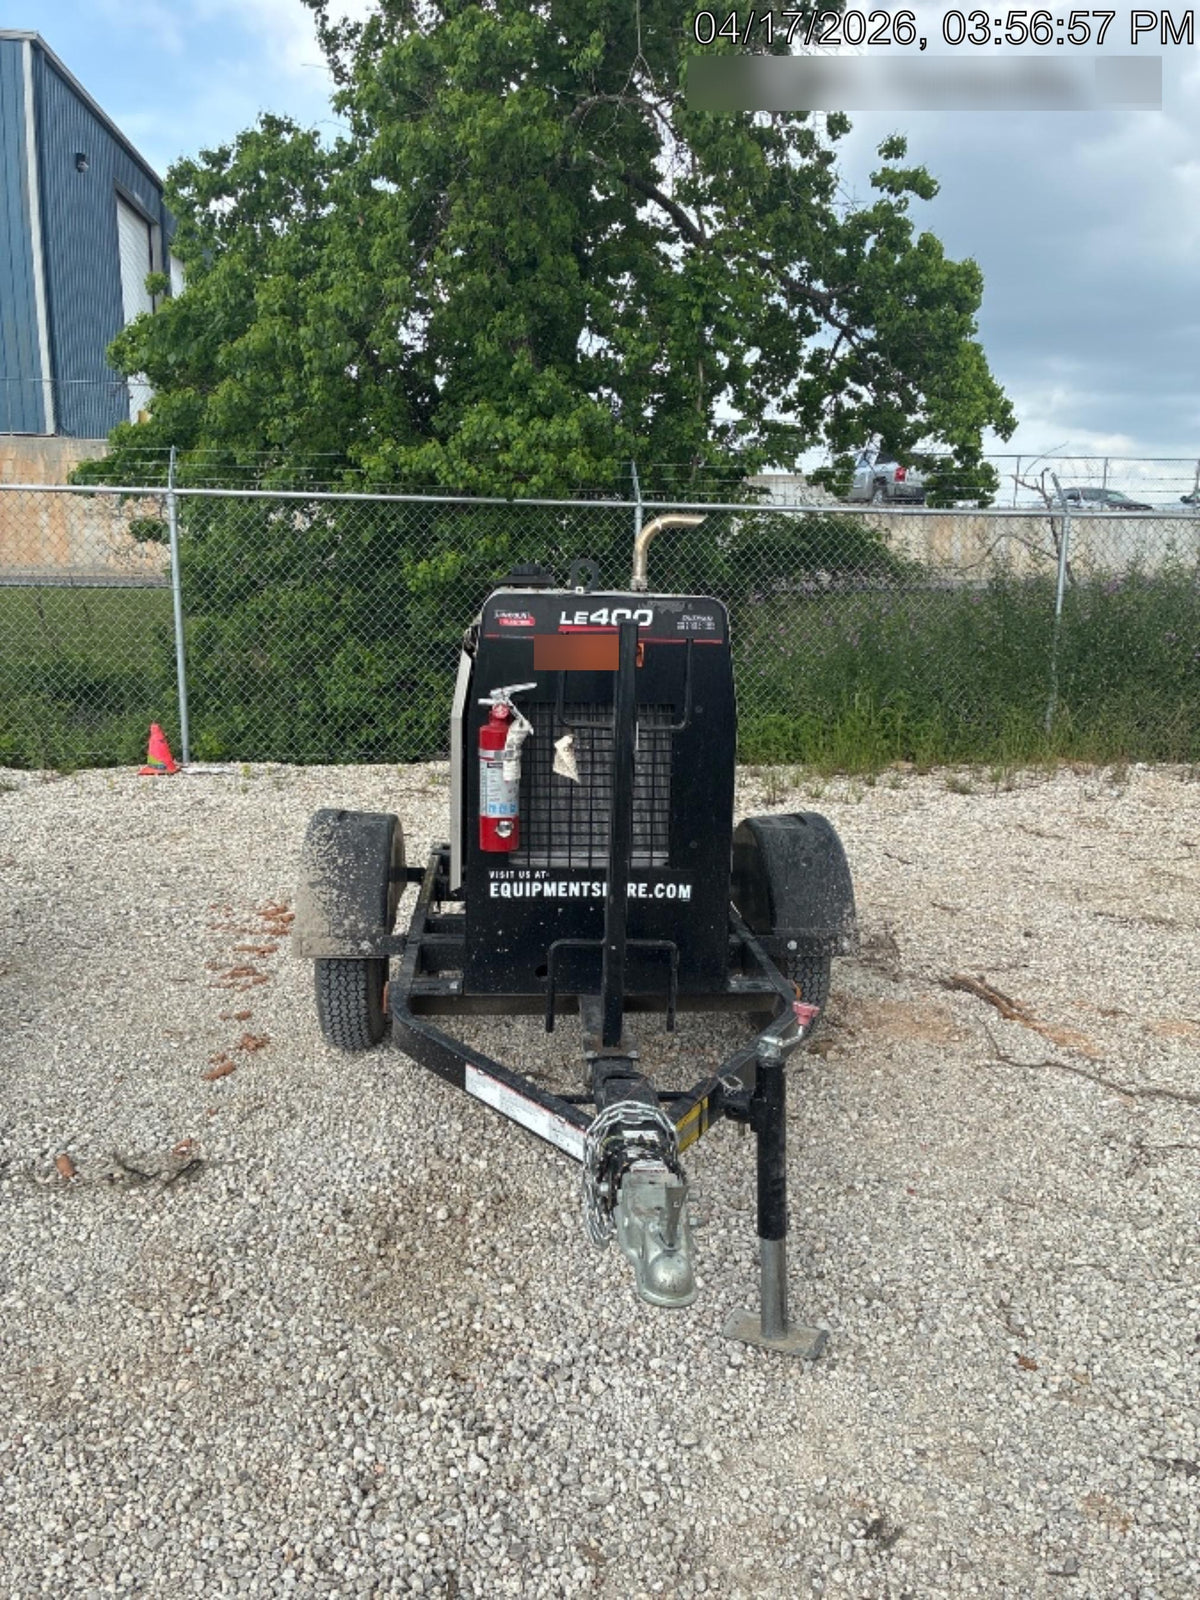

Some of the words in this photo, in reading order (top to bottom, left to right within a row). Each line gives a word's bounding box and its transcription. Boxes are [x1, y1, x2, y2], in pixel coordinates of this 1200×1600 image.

[559, 607, 654, 627] LE400
[488, 870, 515, 879] VISIT
[518, 870, 531, 879] US
[489, 881, 692, 899] EQUIPMENTSRE.COM
